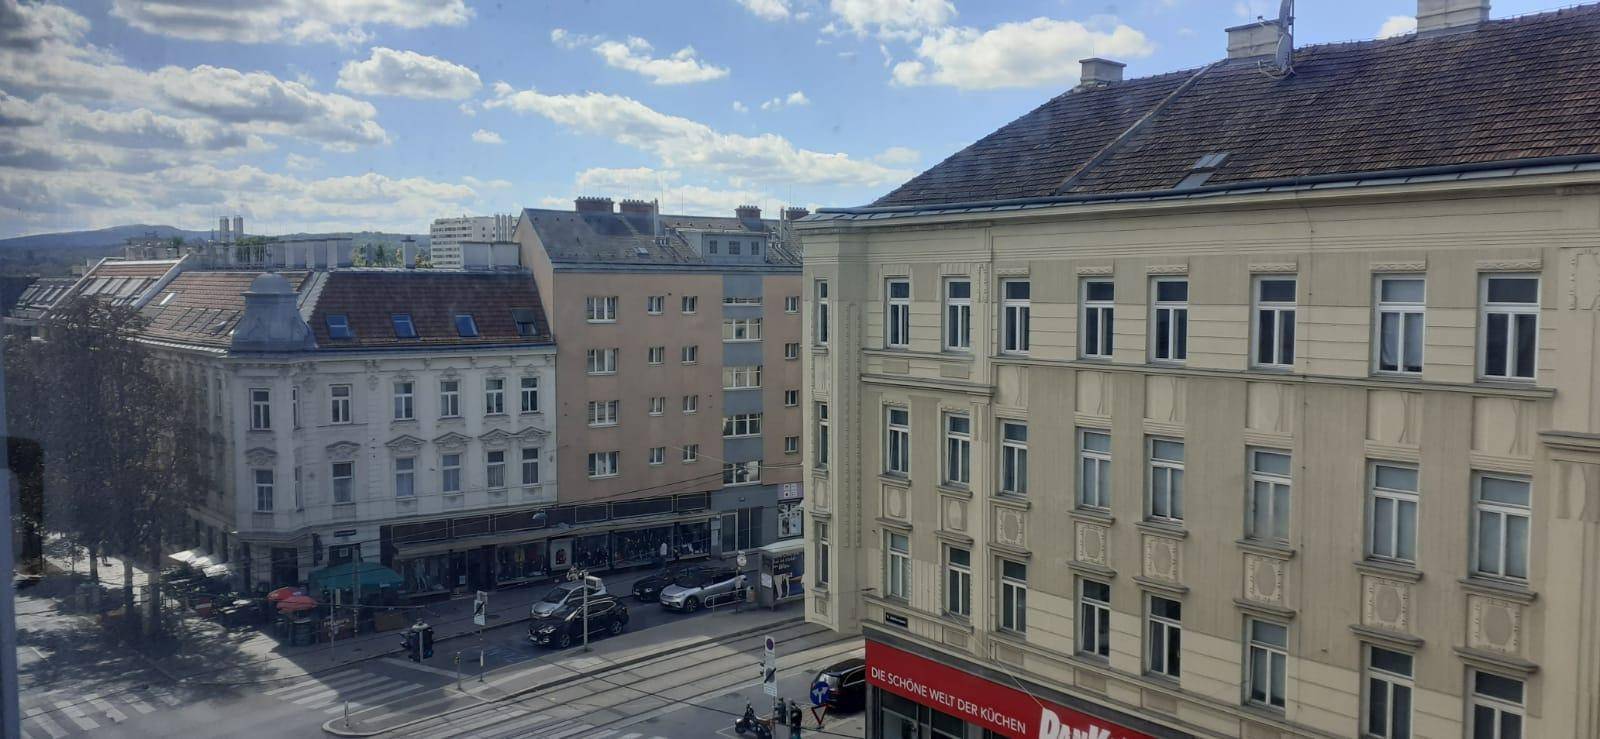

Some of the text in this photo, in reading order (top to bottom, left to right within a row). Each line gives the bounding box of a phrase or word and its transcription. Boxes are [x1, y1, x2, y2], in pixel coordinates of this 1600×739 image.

[871, 666, 1026, 735] DIE SCHÖNE WELT DER KÜCHEN
